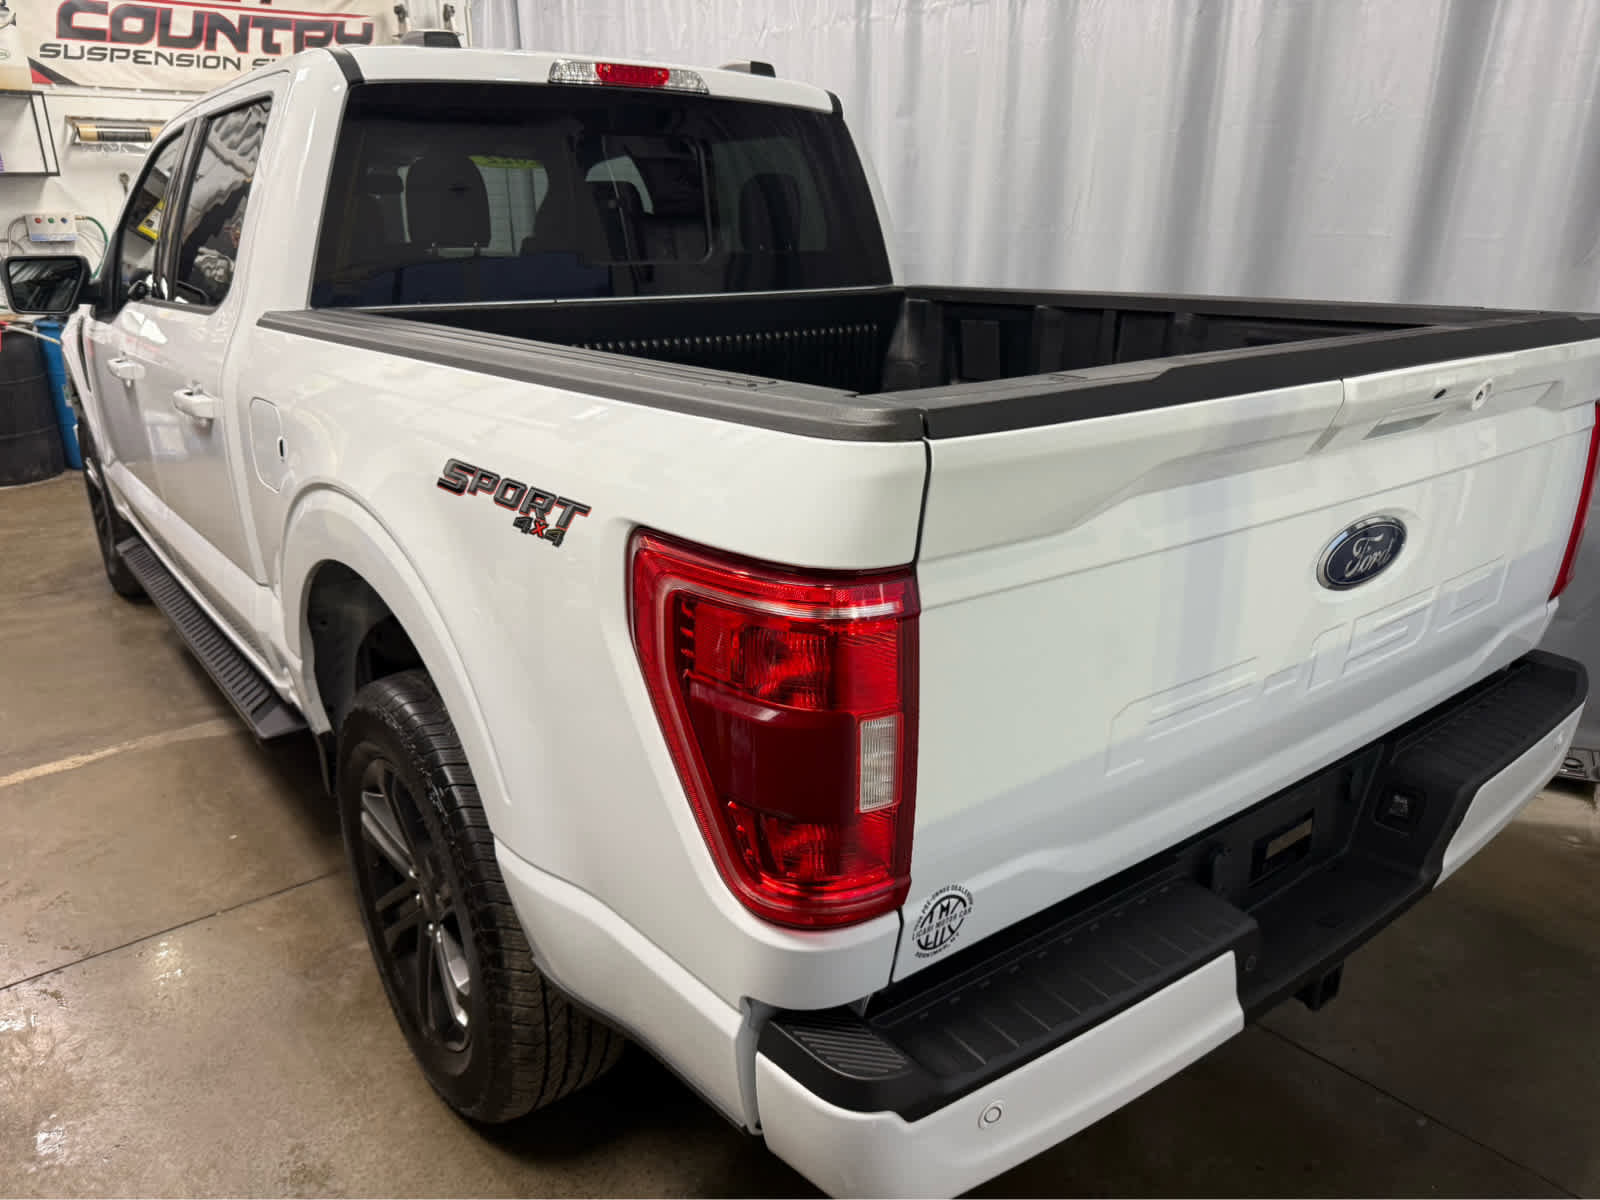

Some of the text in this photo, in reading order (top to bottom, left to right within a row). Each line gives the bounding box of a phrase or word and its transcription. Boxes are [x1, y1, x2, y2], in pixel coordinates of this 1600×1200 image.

[56, 0, 375, 55] COUNTRY
[40, 43, 242, 72] SUSPENSION
[437, 458, 592, 531] SPORT
[513, 516, 566, 548] 4x4
[1344, 534, 1396, 578] Ford
